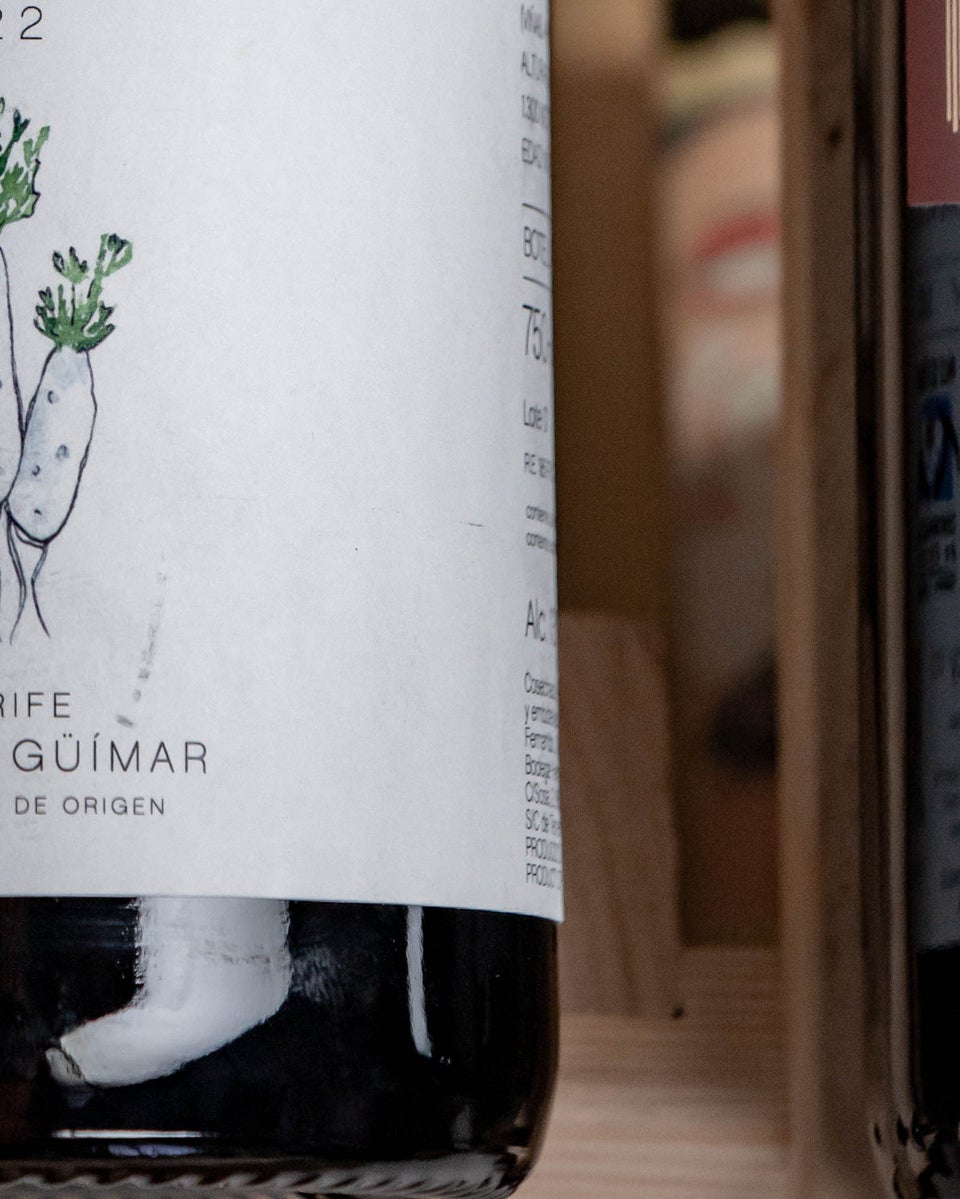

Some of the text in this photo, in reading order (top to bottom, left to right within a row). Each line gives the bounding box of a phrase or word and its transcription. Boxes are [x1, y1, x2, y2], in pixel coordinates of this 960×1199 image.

[11, 731, 207, 775] GÜÍMAR
[14, 795, 47, 816] DE
[62, 795, 165, 816] ORIGEN
